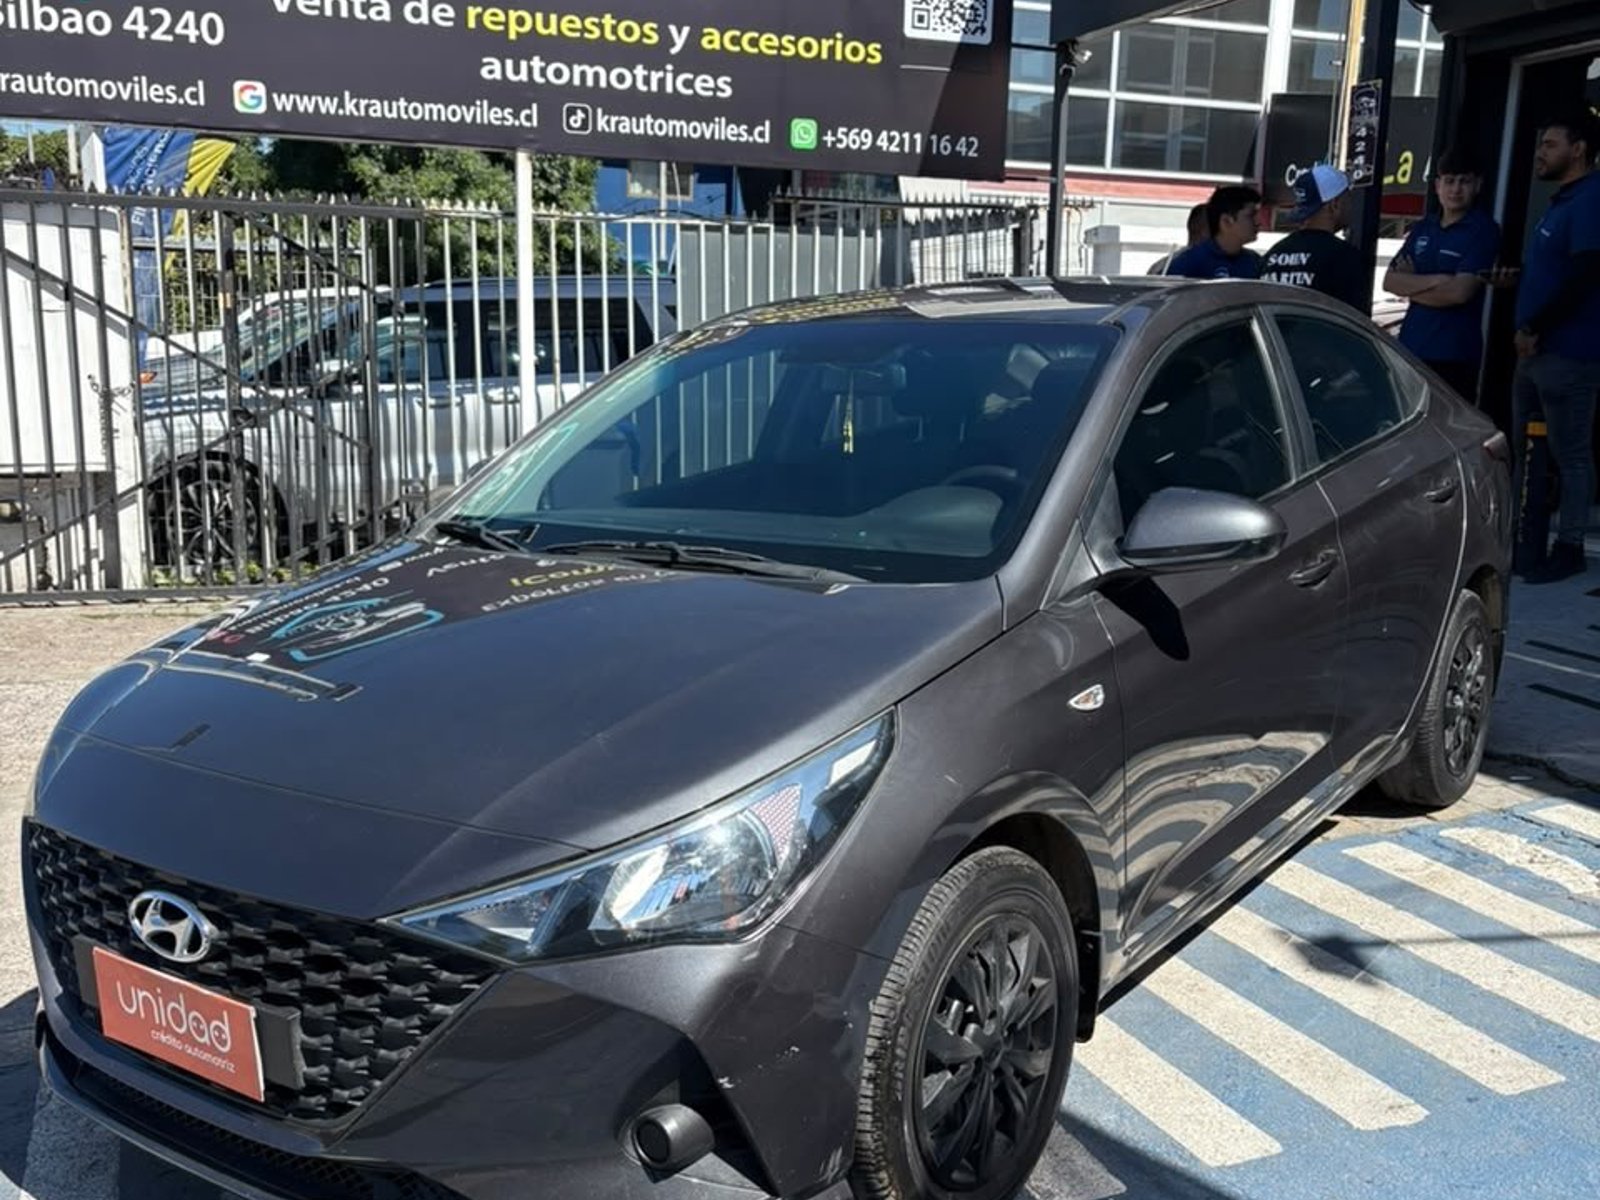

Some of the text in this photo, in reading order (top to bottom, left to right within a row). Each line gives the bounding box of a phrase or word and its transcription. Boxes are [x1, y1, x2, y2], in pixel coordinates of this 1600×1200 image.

[122, 5, 225, 46] 4240
[403, 0, 456, 27] de
[466, 4, 660, 45] repuestos
[668, 23, 691, 54] y
[701, 26, 883, 65] accesorios
[479, 54, 733, 98] automotrices
[0, 71, 205, 106] rautomoviles.cl
[272, 90, 539, 128] www.krautomoviles.cl
[596, 108, 771, 144] krautomoviles.cl
[822, 126, 873, 151] +569
[876, 129, 923, 155] 4211
[929, 133, 952, 156] 16
[955, 136, 979, 158] 42
[116, 980, 232, 1053] unidad
